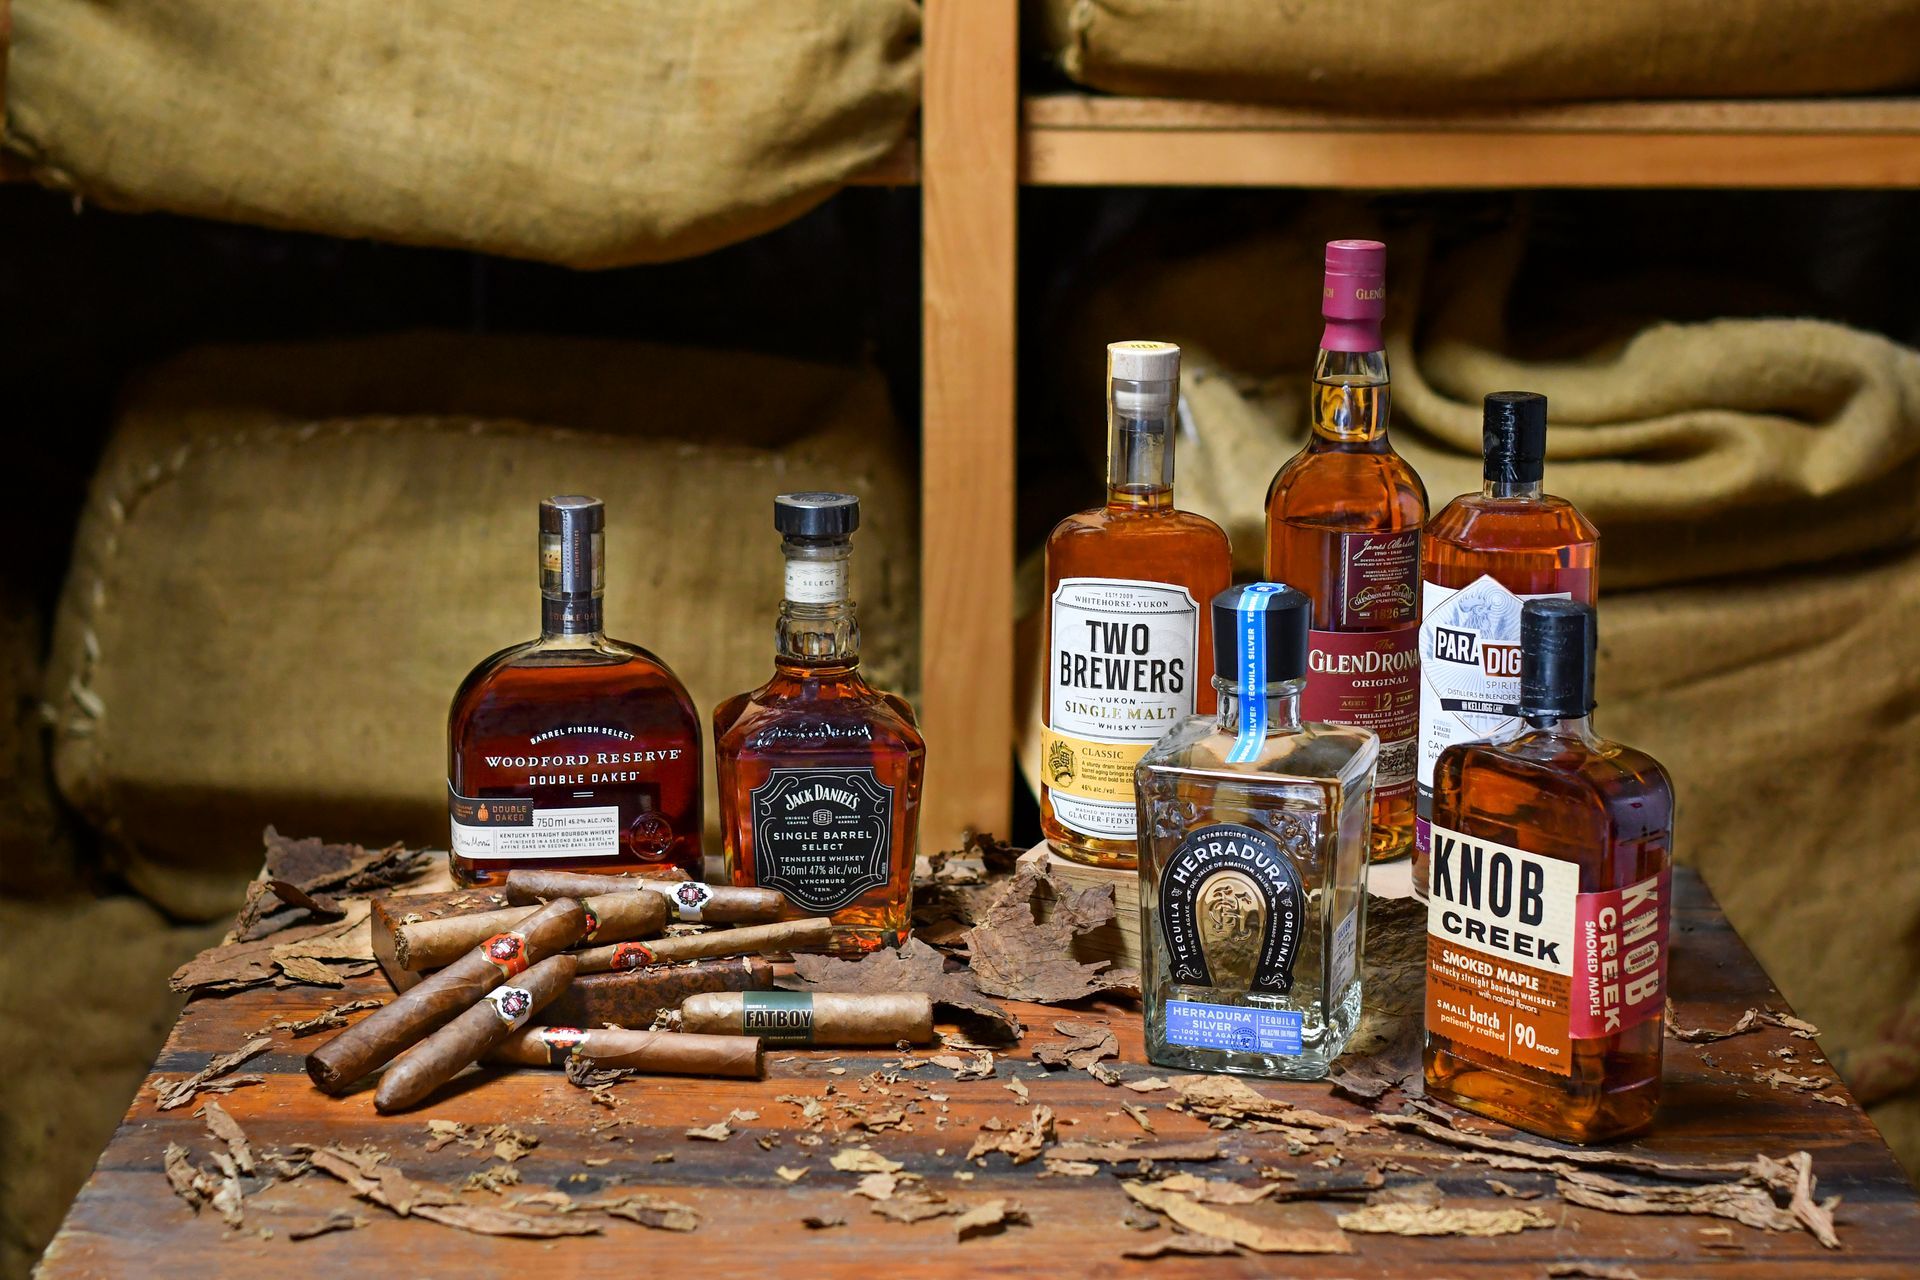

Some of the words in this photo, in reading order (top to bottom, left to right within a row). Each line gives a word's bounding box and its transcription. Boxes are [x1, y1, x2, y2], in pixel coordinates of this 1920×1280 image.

[1074, 595, 1131, 608] WHITEHORSE
[1137, 600, 1169, 608] YUKON
[1375, 607, 1399, 619] 1826
[1085, 619, 1150, 656] TWO
[1437, 630, 1480, 662] PARA
[1060, 650, 1185, 694] BREWERS
[1248, 662, 1256, 701] TEQUILA
[1352, 675, 1408, 688] ORIGINAL
[1099, 697, 1136, 705] YUKON
[1373, 692, 1393, 712] 12
[1447, 688, 1478, 698] DISTILLERS
[1065, 701, 1122, 720] SINGLE
[1127, 707, 1177, 720] MALT
[1467, 701, 1493, 712] KELLOGG
[1098, 722, 1137, 731] WHISKY
[1249, 705, 1257, 737] SILVER
[530, 728, 566, 745] BARREL
[567, 726, 599, 734] FINISH
[601, 727, 636, 742] SELECT
[485, 754, 590, 768] WOODFORD
[596, 750, 680, 765] RESERVE
[1081, 747, 1124, 760] CLASSIC
[529, 774, 585, 786] DOUBLE
[591, 772, 637, 783] OAKED
[1109, 770, 1125, 778] brings
[784, 788, 816, 811] JACK
[492, 805, 527, 814] DOUBLE
[495, 813, 525, 822] OAKED
[1068, 811, 1122, 825] GLACIER-FED
[536, 817, 567, 828] 750ml
[500, 831, 530, 839] KENTUCKY
[773, 831, 818, 840] SINGLE
[823, 830, 872, 839] BARREL
[1197, 832, 1247, 842] ESTABLECIDO
[1250, 836, 1267, 847] 1870
[802, 843, 844, 851] SELECT
[781, 865, 807, 876] 750ml
[809, 864, 826, 875] 47%
[828, 864, 864, 875] alc./vol.
[1173, 841, 1288, 895] HERRADURA
[1190, 878, 1200, 890] DEL
[1197, 864, 1213, 879] VALLE
[1255, 873, 1273, 897] JALISCO
[1433, 833, 1545, 927] KNOB
[798, 888, 819, 901] MASTER
[820, 887, 848, 902] DISTILLED
[1184, 905, 1192, 927] AGAVE
[1171, 903, 1189, 960] TEQUILA
[1274, 911, 1294, 968] ORIGINAL
[1441, 911, 1561, 965] CREEK
[1621, 876, 1660, 1006] KNOB
[1585, 920, 1599, 973] SMOKED
[1442, 949, 1493, 977] SMOKED
[1496, 967, 1539, 991] MAPLE
[1598, 906, 1621, 1033] CREEK
[1432, 959, 1460, 981] kentucky
[1461, 970, 1489, 989] straight
[1490, 980, 1520, 998] bourbon
[1520, 992, 1557, 1008] WHISKEY
[1478, 990, 1492, 999] with
[1492, 995, 1515, 1007] natural
[1515, 1000, 1538, 1014] flavors
[1588, 976, 1601, 1017] MAPLE
[744, 1009, 813, 1028] FATBOY
[1173, 1006, 1251, 1022] HERRADURA
[1260, 1016, 1297, 1026] TEQUILA
[1436, 999, 1467, 1017] SMALL
[1469, 1004, 1500, 1030] batch
[1181, 1028, 1199, 1036] 100%
[1215, 1032, 1242, 1040] AGAVE
[1192, 1020, 1232, 1032] SILVER
[1440, 1013, 1474, 1033] patiently
[1476, 1024, 1506, 1042] crafted
[1514, 1022, 1536, 1049] 90
[1536, 1043, 1560, 1056] PROOF
